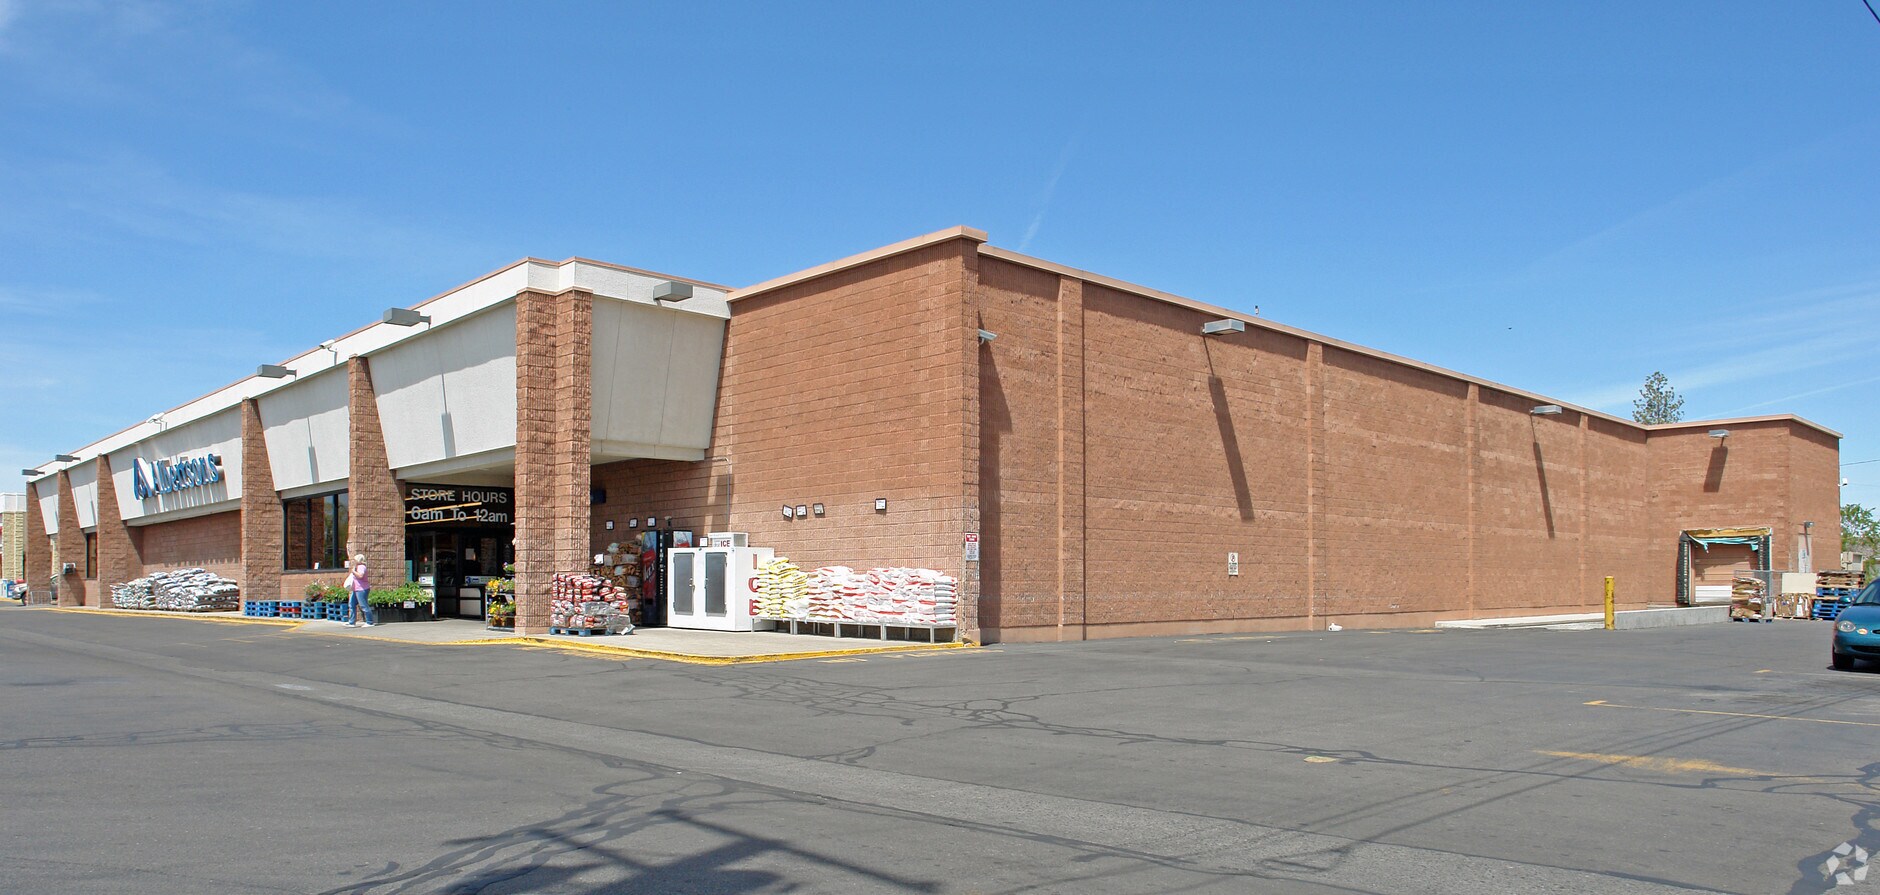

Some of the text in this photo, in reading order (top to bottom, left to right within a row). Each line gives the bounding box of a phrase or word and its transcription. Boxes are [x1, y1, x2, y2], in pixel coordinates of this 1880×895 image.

[150, 453, 219, 496] Albertsons
[411, 488, 508, 504] STORE HOURS
[411, 506, 508, 523] 6am To 12am
